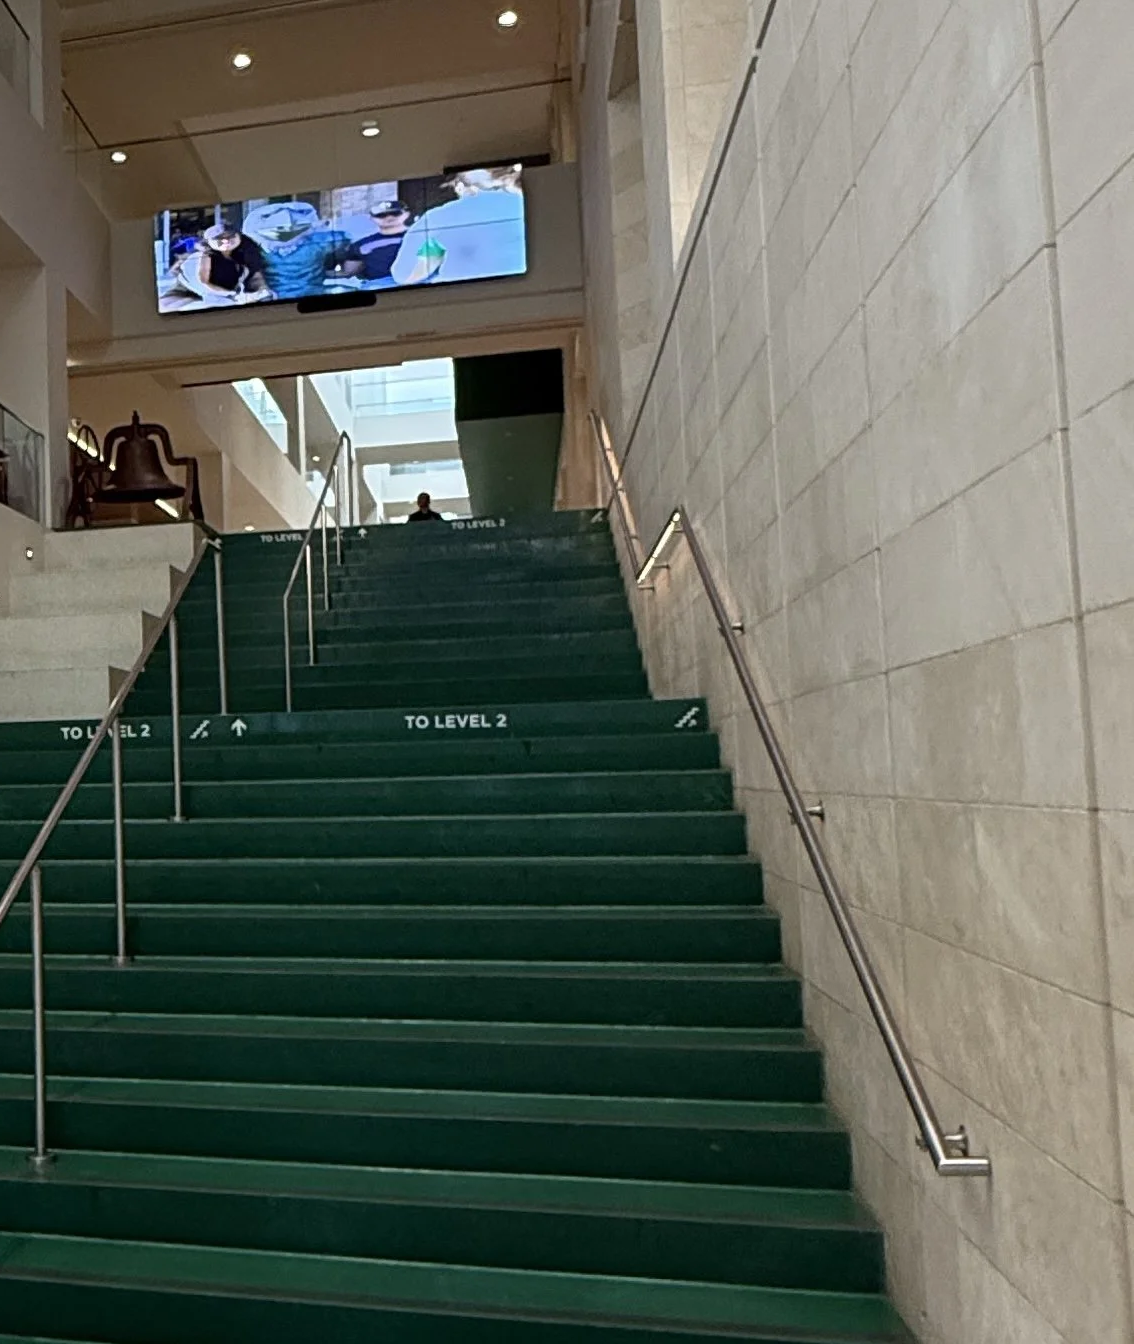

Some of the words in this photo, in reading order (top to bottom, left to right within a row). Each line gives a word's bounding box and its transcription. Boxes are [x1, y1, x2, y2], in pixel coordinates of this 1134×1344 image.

[451, 520, 465, 530] TO
[467, 519, 497, 529] LEVEL
[404, 715, 430, 729] TO
[434, 714, 492, 729] LEVEL
[496, 713, 507, 728] 2
[60, 726, 83, 740] TO
[140, 723, 151, 737] 2
